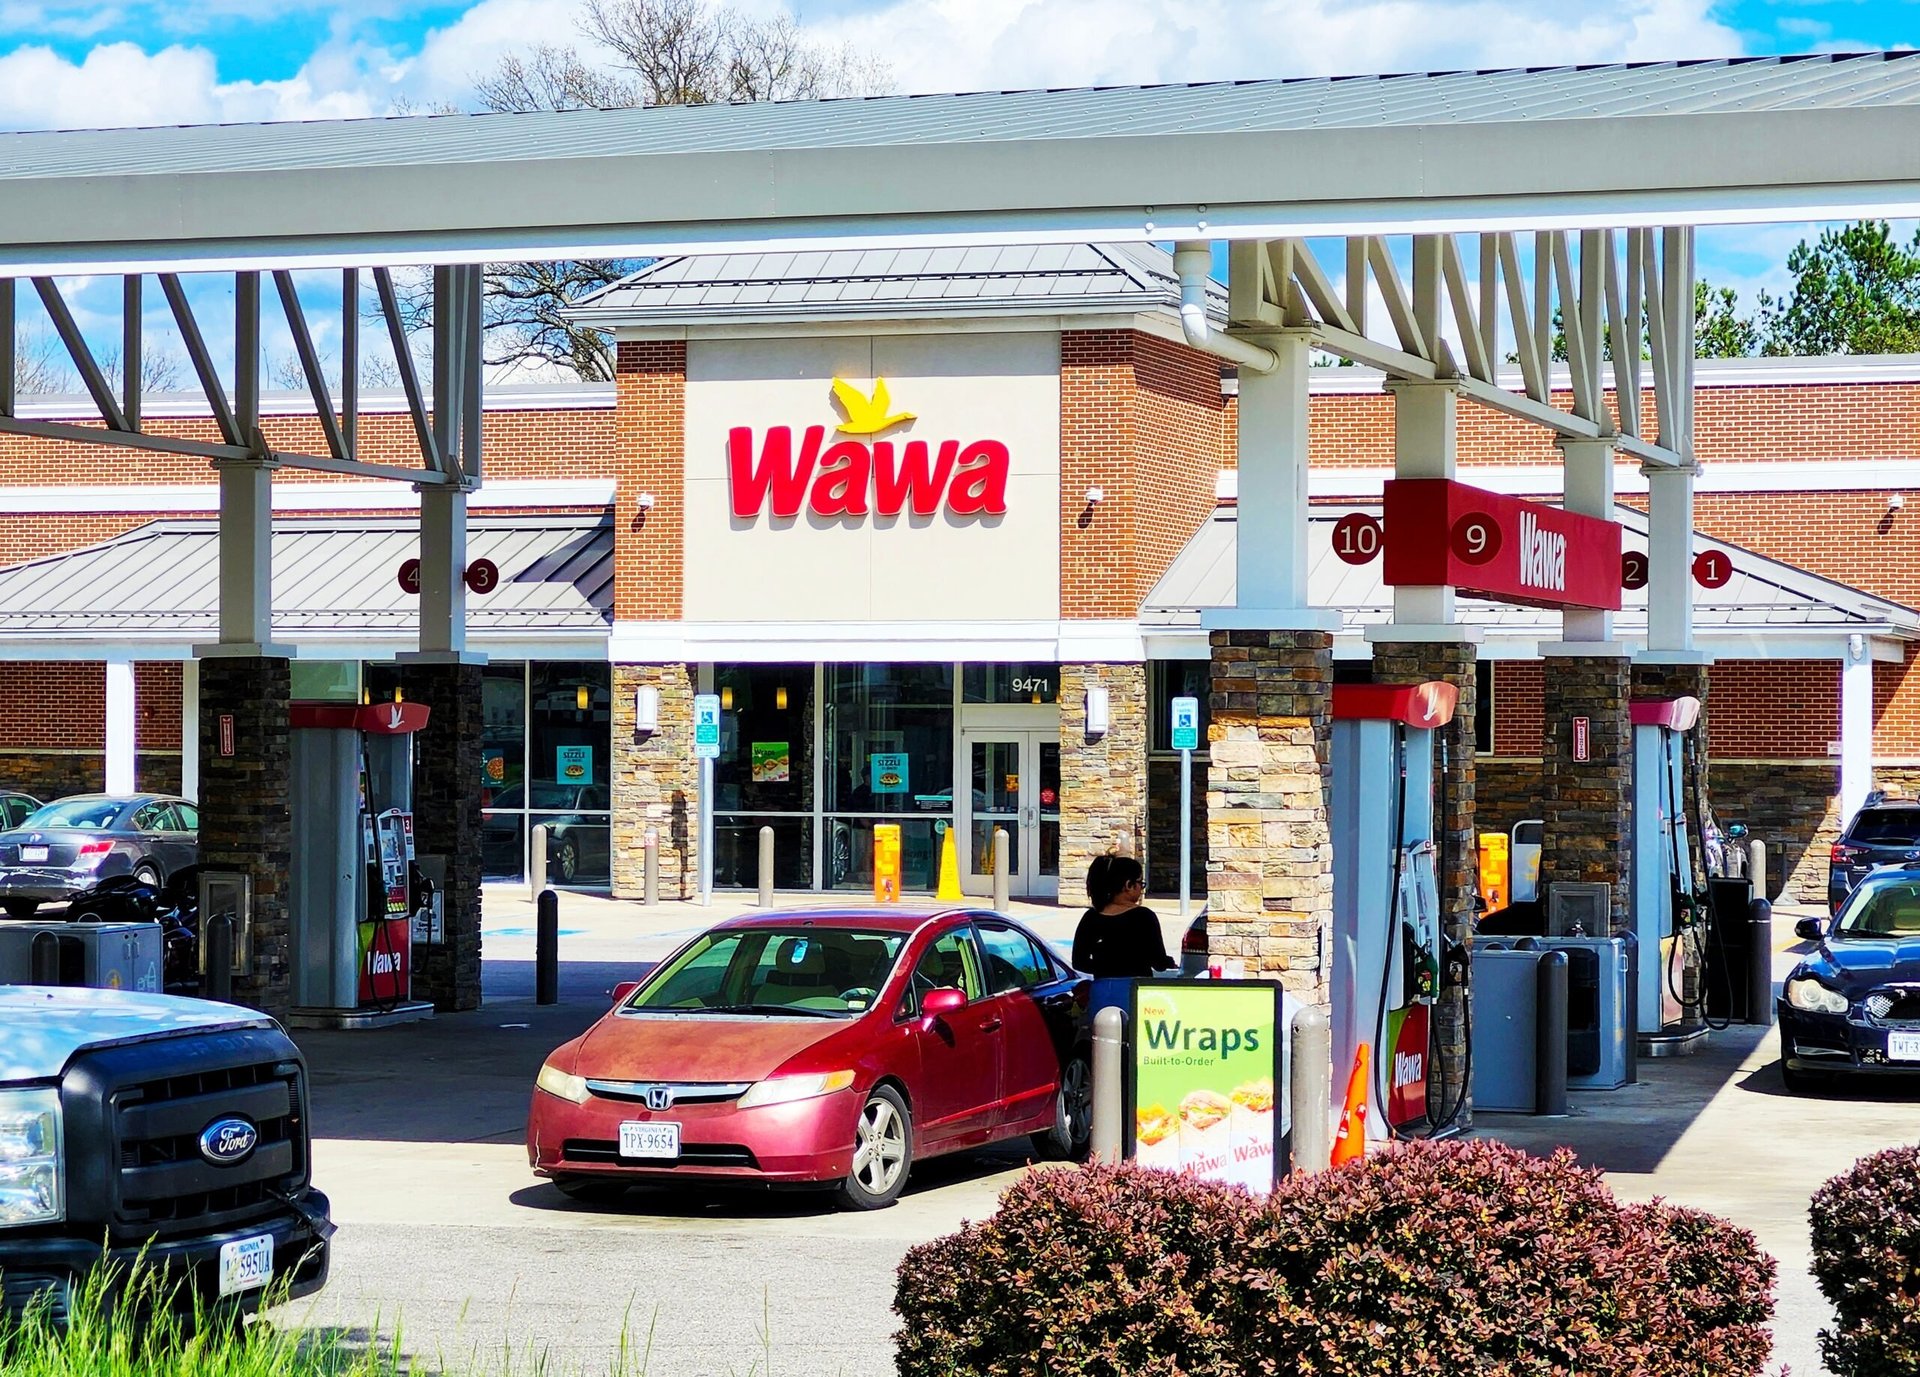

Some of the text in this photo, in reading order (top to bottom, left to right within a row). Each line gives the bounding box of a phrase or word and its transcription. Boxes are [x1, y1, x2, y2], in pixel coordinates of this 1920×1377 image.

[728, 424, 1010, 518] Wawa
[1340, 525, 1377, 555] 10
[1465, 524, 1487, 554] 9
[1519, 510, 1566, 592] Wawa
[407, 567, 421, 587] 4
[476, 567, 489, 587] 3
[1625, 560, 1640, 582] 2
[1705, 559, 1718, 582] 1
[1012, 678, 1048, 692] 9471
[1143, 1007, 1166, 1016] New
[1144, 1019, 1260, 1060] Wraps
[1143, 1056, 1215, 1066] Built-to-Order
[1395, 1051, 1422, 1089] Wawa
[218, 1126, 252, 1153] Ford
[624, 1132, 674, 1149] TPX-9654
